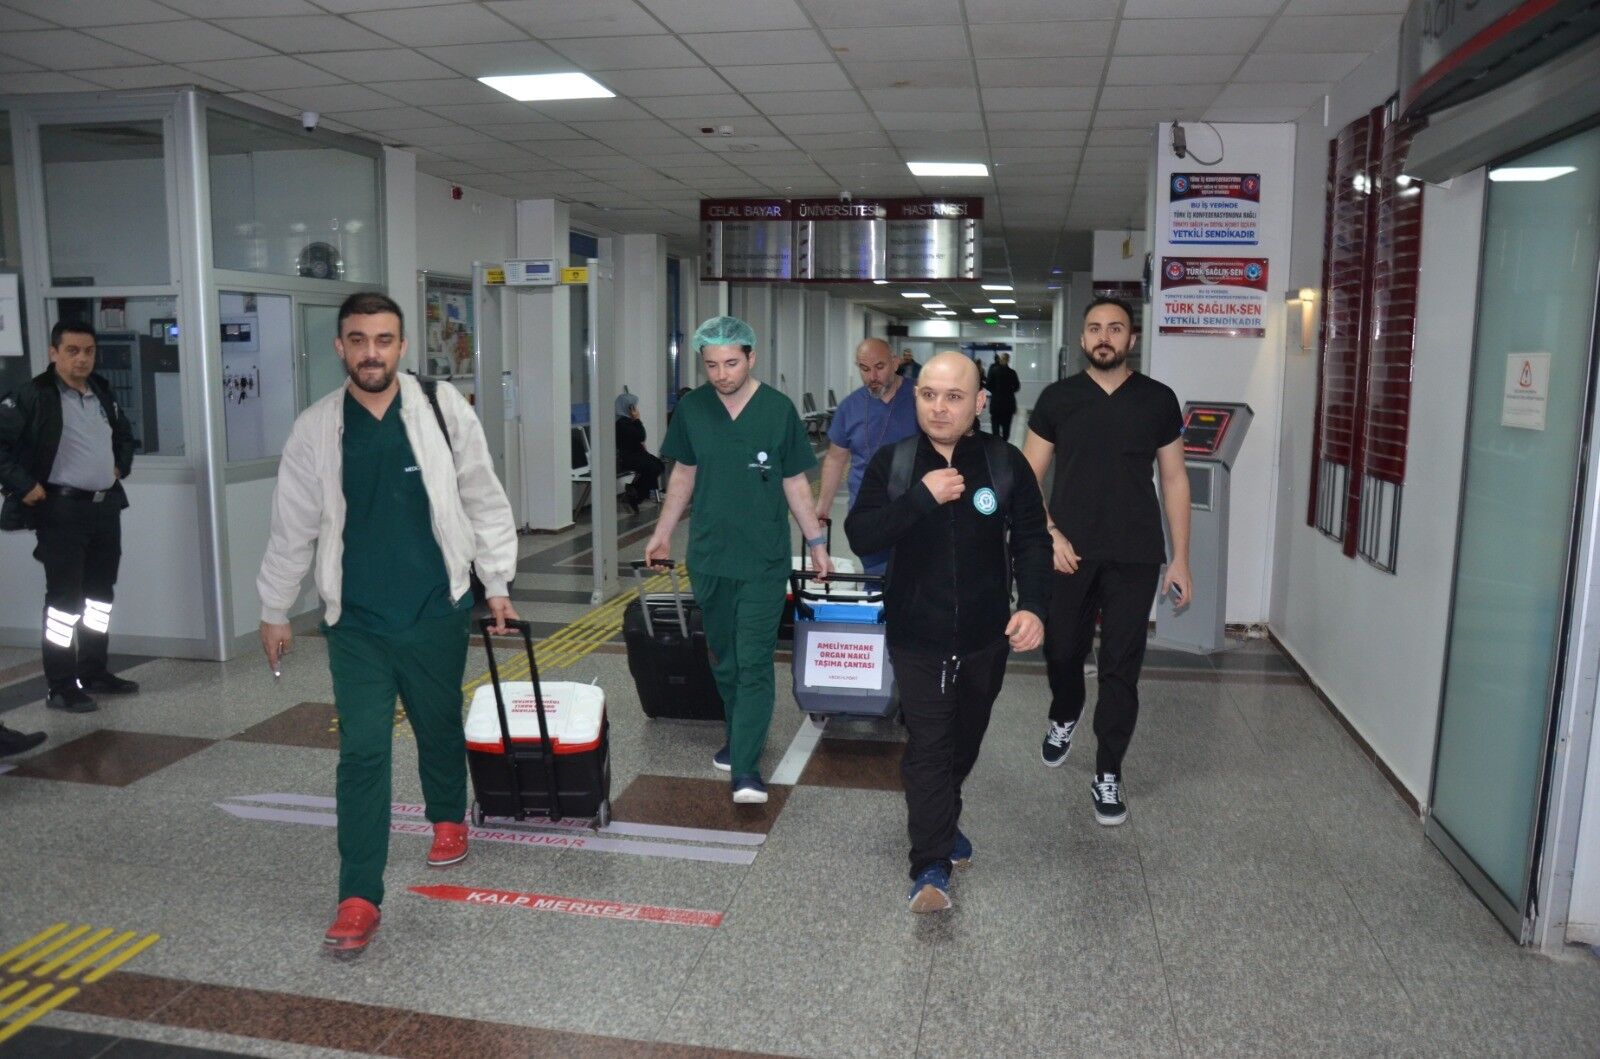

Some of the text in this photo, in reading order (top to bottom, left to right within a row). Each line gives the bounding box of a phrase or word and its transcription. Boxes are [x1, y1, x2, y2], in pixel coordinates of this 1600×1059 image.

[708, 202, 969, 217] CELAL BAYAR ÜNİVERSİTESİ HASTANESİ
[1202, 202, 1208, 210] İŞ
[1172, 228, 1255, 239] YETKİLİ SENDİKADIR
[1186, 267, 1203, 276] TÜRK
[1164, 300, 1262, 315] TÜRK SAĞLIK-SEN
[1164, 316, 1262, 326] YETKİLİ SENDİKADIR
[817, 642, 874, 651] AMELİYATHANE
[847, 652, 870, 660] NAKLİ
[814, 660, 875, 669] TAŞIMA ÇANTASI
[466, 892, 530, 905] KALP
